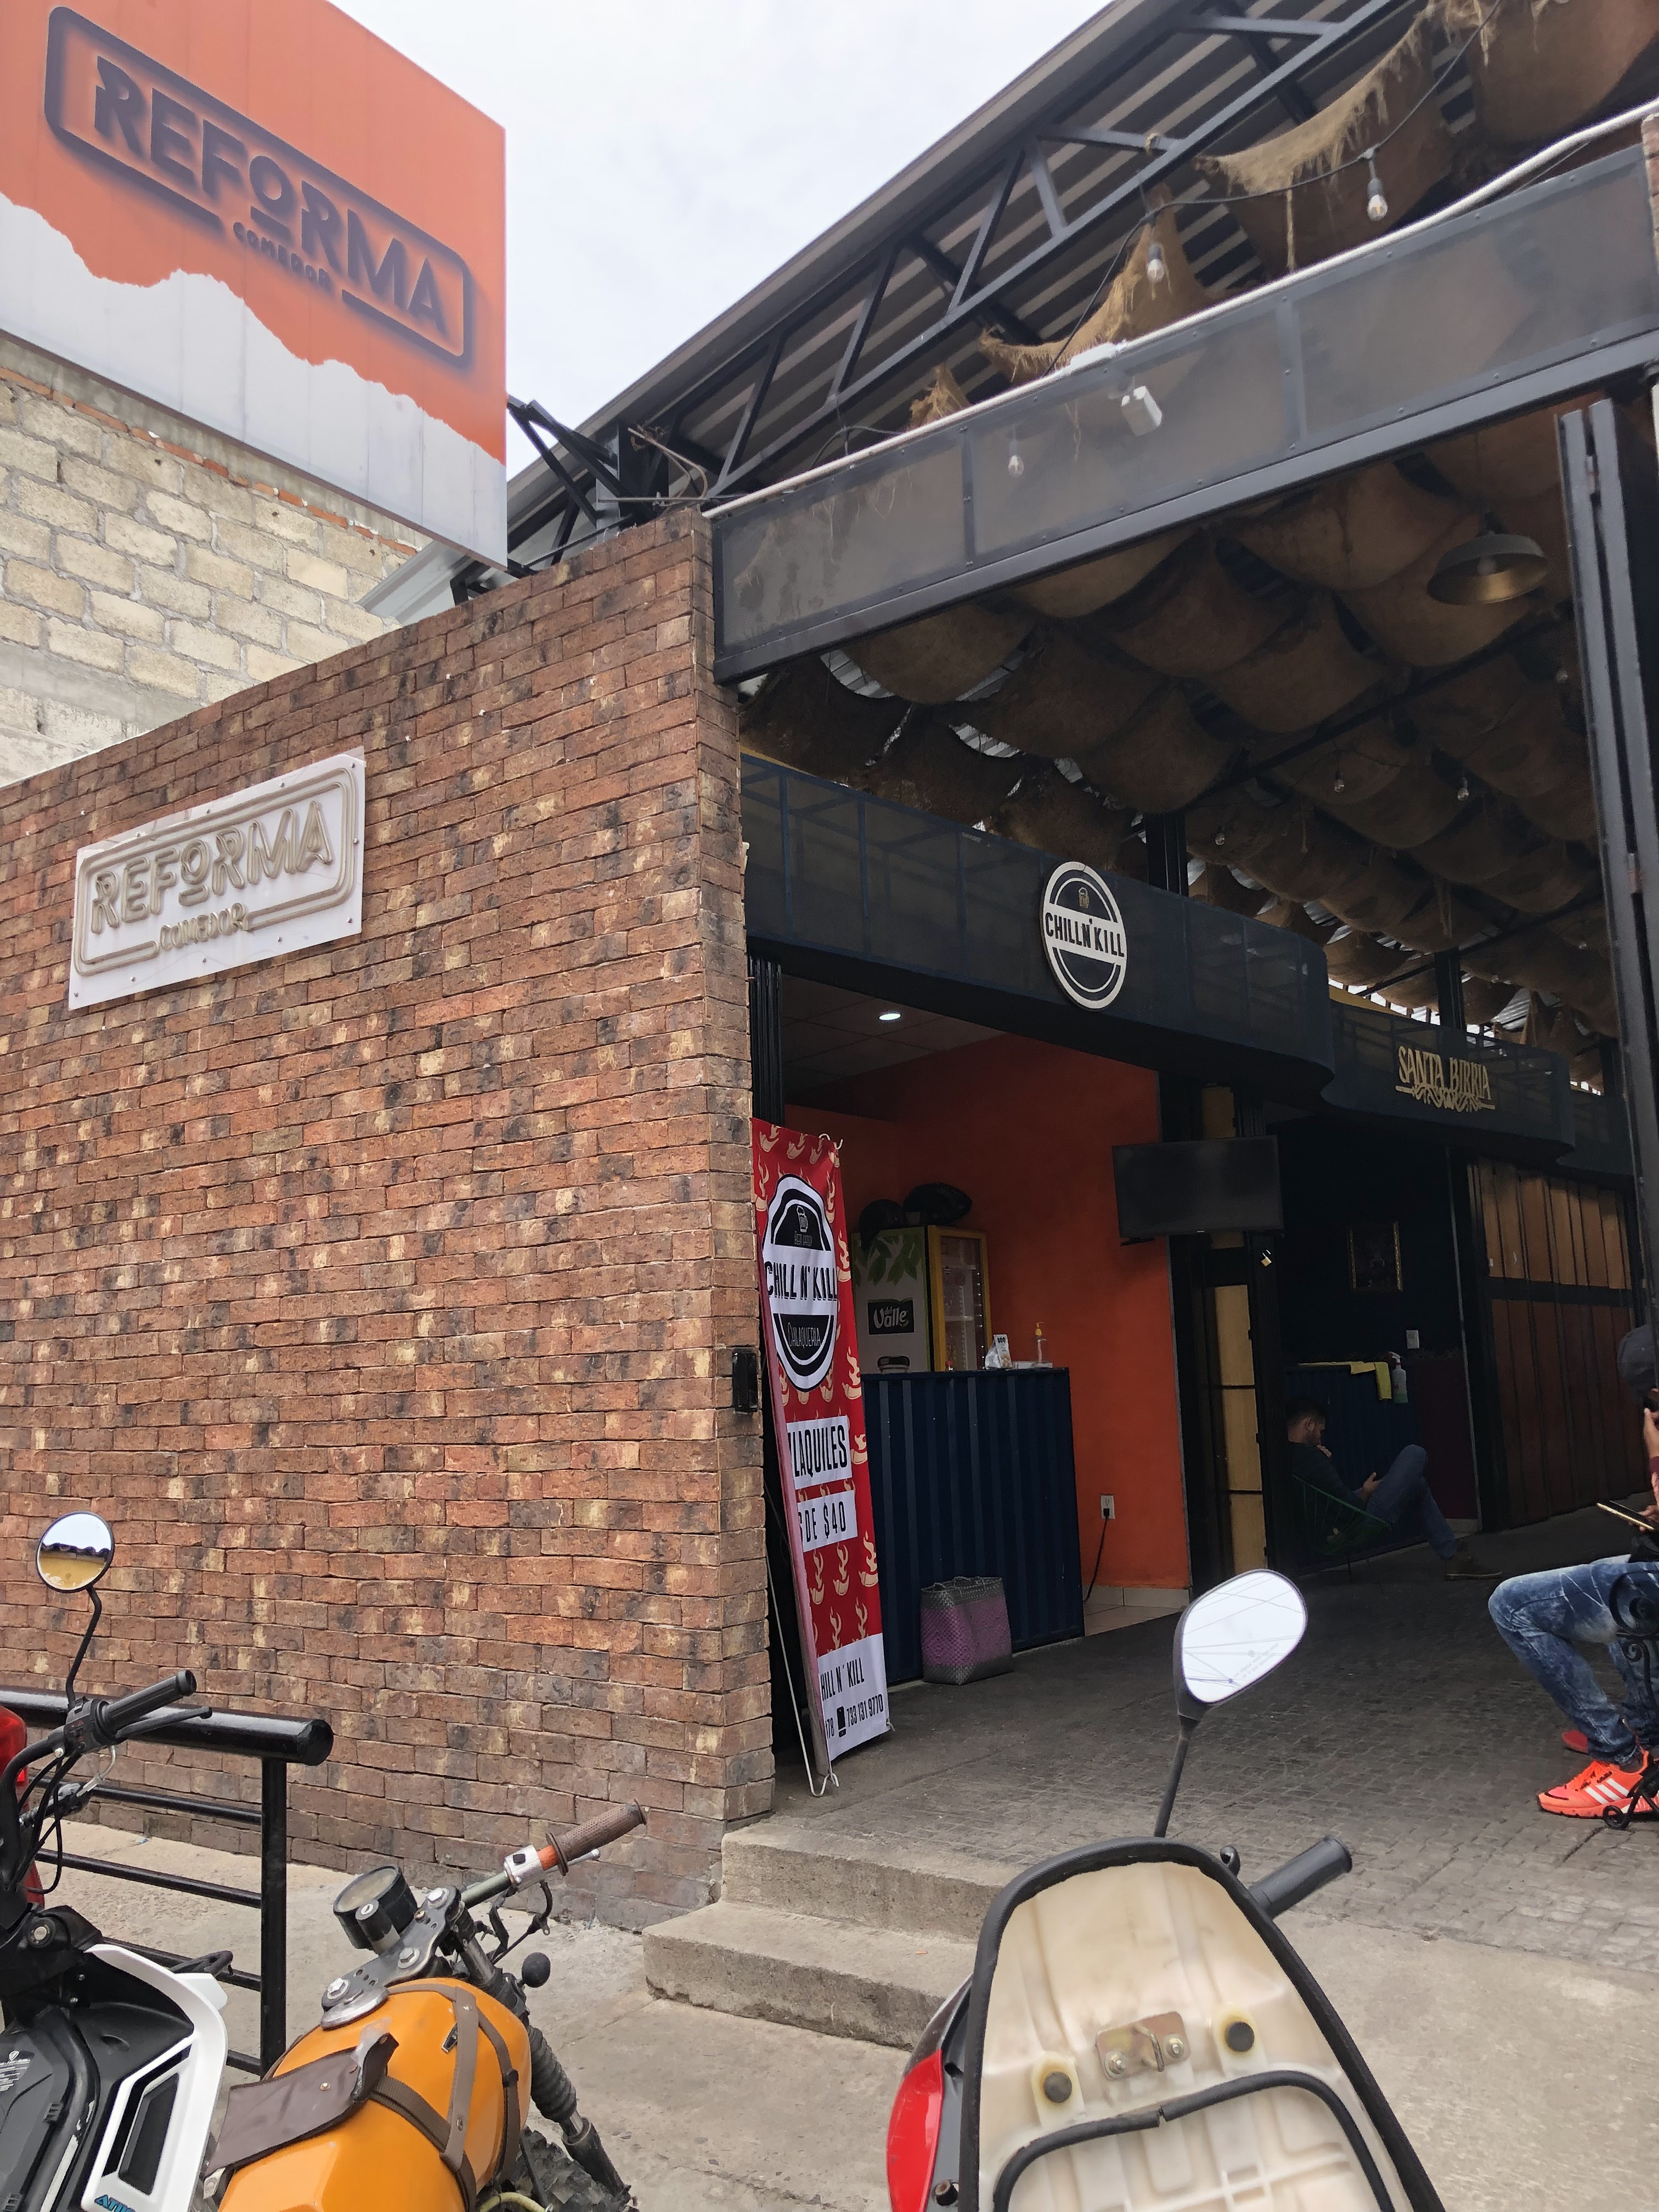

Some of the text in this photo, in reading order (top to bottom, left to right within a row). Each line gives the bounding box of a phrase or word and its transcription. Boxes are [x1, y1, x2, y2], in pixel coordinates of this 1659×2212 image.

[94, 55, 444, 331] REFORMA
[233, 222, 333, 292] COMEDOR
[91, 800, 334, 934] REFORMA
[160, 902, 246, 951] COMEDOR
[1045, 912, 1082, 946] CHILL
[1094, 927, 1125, 957] KILL
[1398, 1046, 1492, 1100] SANTA BIRRIA
[765, 1261, 797, 1299] CHILL
[813, 1267, 838, 1301] KILL
[873, 1307, 907, 1329] Valle
[823, 1502, 847, 1539] $40
[847, 1657, 865, 1688] KILL
[847, 1706, 857, 1728] 733
[858, 1701, 868, 1722] 131
